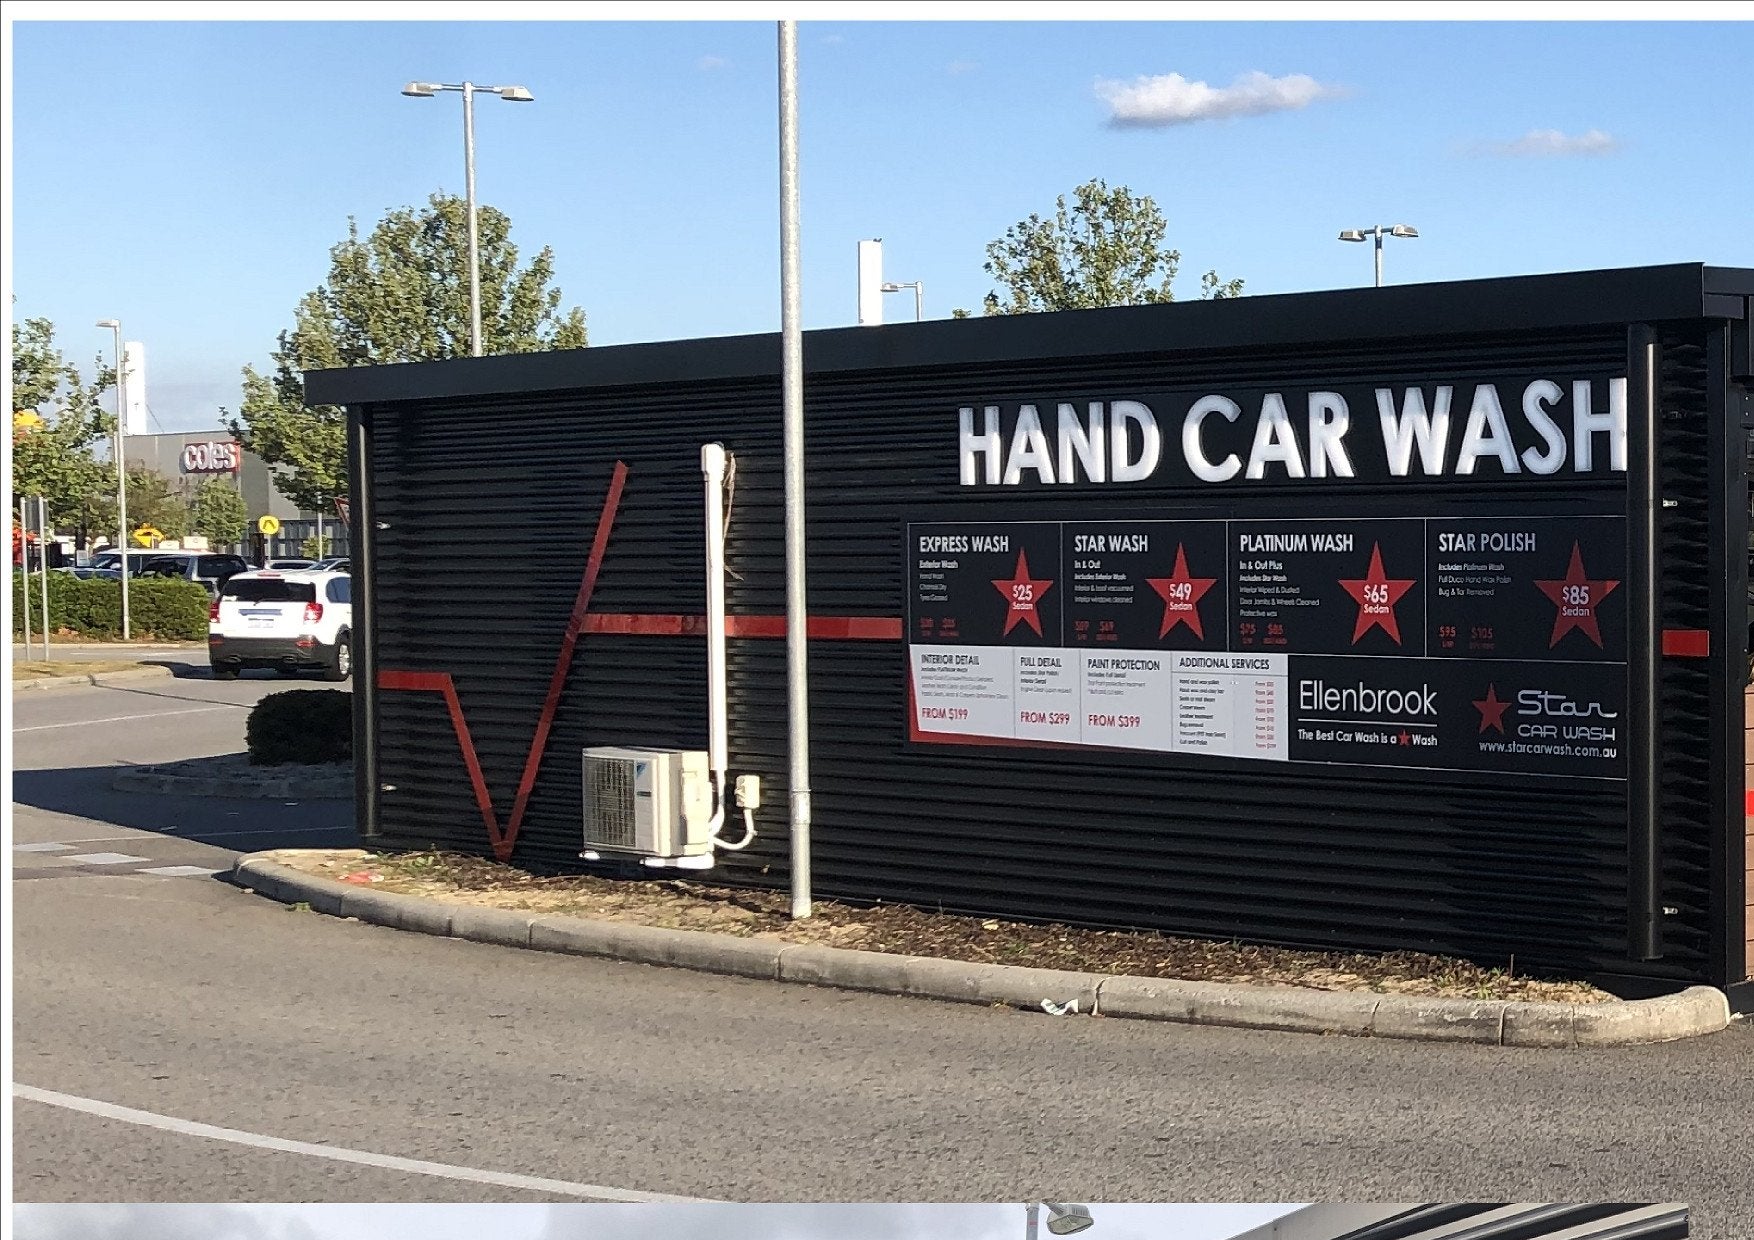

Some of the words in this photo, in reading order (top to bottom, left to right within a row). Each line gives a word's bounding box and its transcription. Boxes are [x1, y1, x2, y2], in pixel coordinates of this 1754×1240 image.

[959, 400, 1161, 485] HAND
[1182, 392, 1356, 483] CAR
[1375, 377, 1627, 477] WASH
[184, 441, 236, 470] coles
[920, 536, 968, 552] EXPRESS
[972, 536, 1009, 552] WASH
[1075, 535, 1105, 552] STAR
[1108, 535, 1148, 552] WASH
[1240, 535, 1307, 552] PLATINUM
[1311, 534, 1353, 551] WASH
[1439, 533, 1476, 551] STAR
[1481, 533, 1535, 551] POLISH
[1013, 585, 1033, 601] $25
[1169, 583, 1191, 600] $49
[1364, 585, 1388, 603] $65
[1562, 586, 1589, 605] $85
[1170, 602, 1192, 610] Sedan
[1364, 605, 1389, 613] Sedan
[1562, 606, 1590, 616] Sedan
[921, 654, 953, 664] INTERIOR
[955, 655, 979, 665] DETAIL
[1021, 657, 1035, 667] FULL
[1038, 658, 1062, 667] DETAIL
[1088, 659, 1109, 669] PAINT
[1111, 659, 1160, 671] PROTECTION
[1179, 658, 1229, 668] ADDITIONAL
[1232, 659, 1269, 670] SERVICES
[1300, 680, 1437, 715] Ellenbrook
[1518, 689, 1617, 718] Star
[922, 708, 946, 719] FROM
[949, 708, 968, 720] $199
[1021, 711, 1046, 723] FROM
[1049, 712, 1070, 725] $299
[1088, 715, 1115, 727] FROM
[1119, 716, 1140, 728] $399
[1298, 729, 1314, 741] The
[1316, 730, 1334, 742] Best
[1336, 731, 1352, 742] Car
[1355, 731, 1378, 744] Wash
[1381, 733, 1388, 744] is
[1390, 736, 1396, 744] a
[1412, 734, 1437, 745] Wash
[1518, 724, 1557, 738] CAR
[1563, 726, 1615, 741] WASH
[1479, 741, 1617, 758] www.starcarwash.com.au
